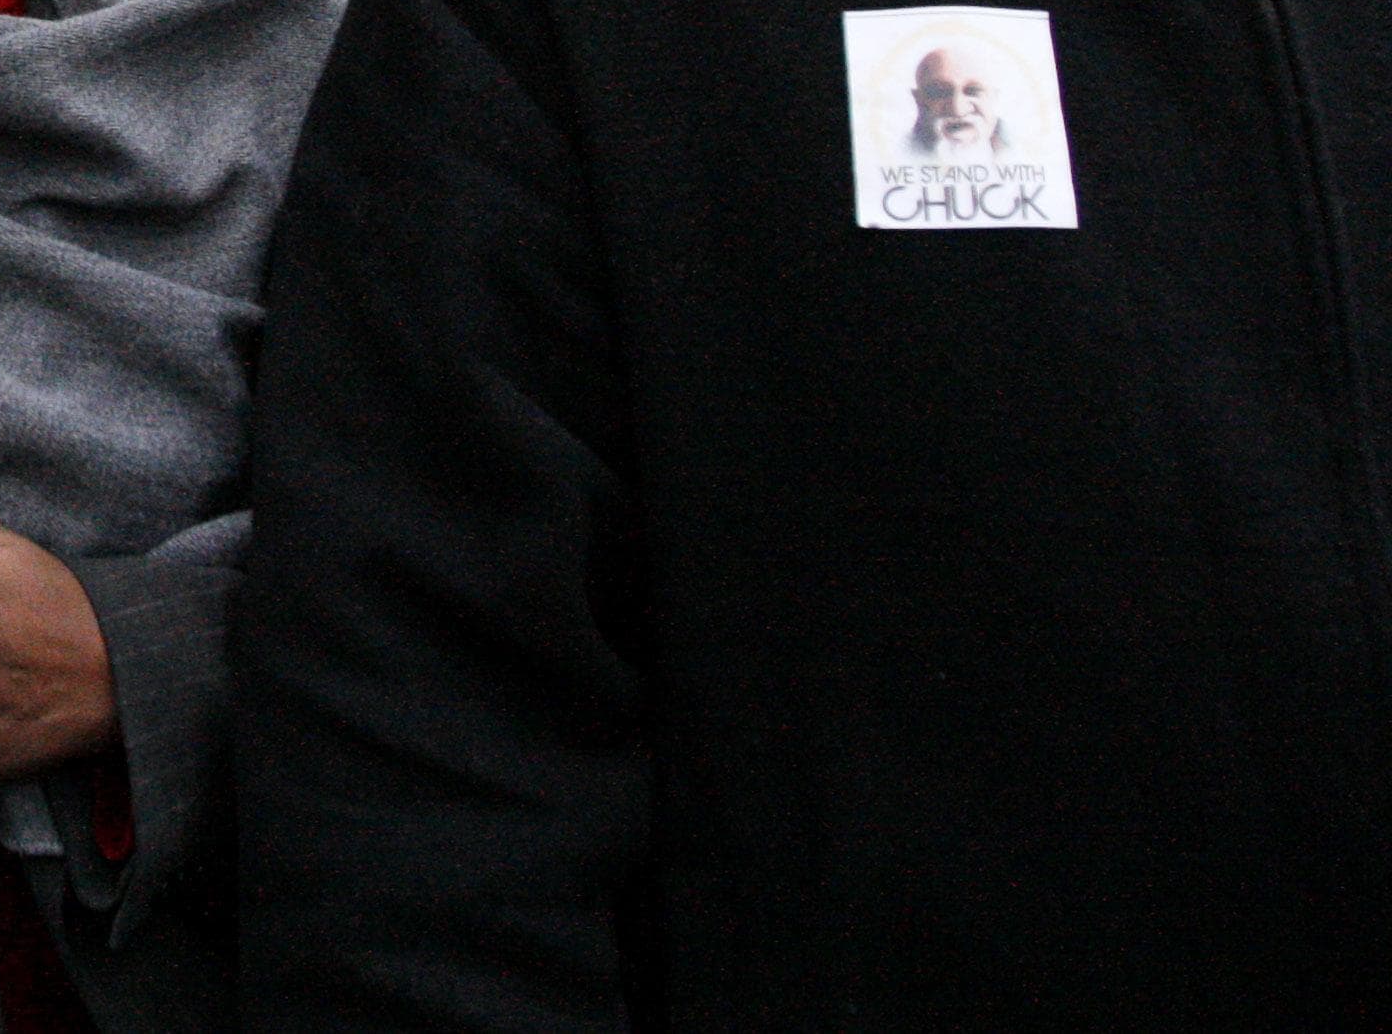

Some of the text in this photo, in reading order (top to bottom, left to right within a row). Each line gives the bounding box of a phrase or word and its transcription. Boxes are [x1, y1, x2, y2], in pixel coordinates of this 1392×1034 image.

[880, 164, 1046, 184] WE STAND WITH
[882, 183, 1050, 222] CHUCK
